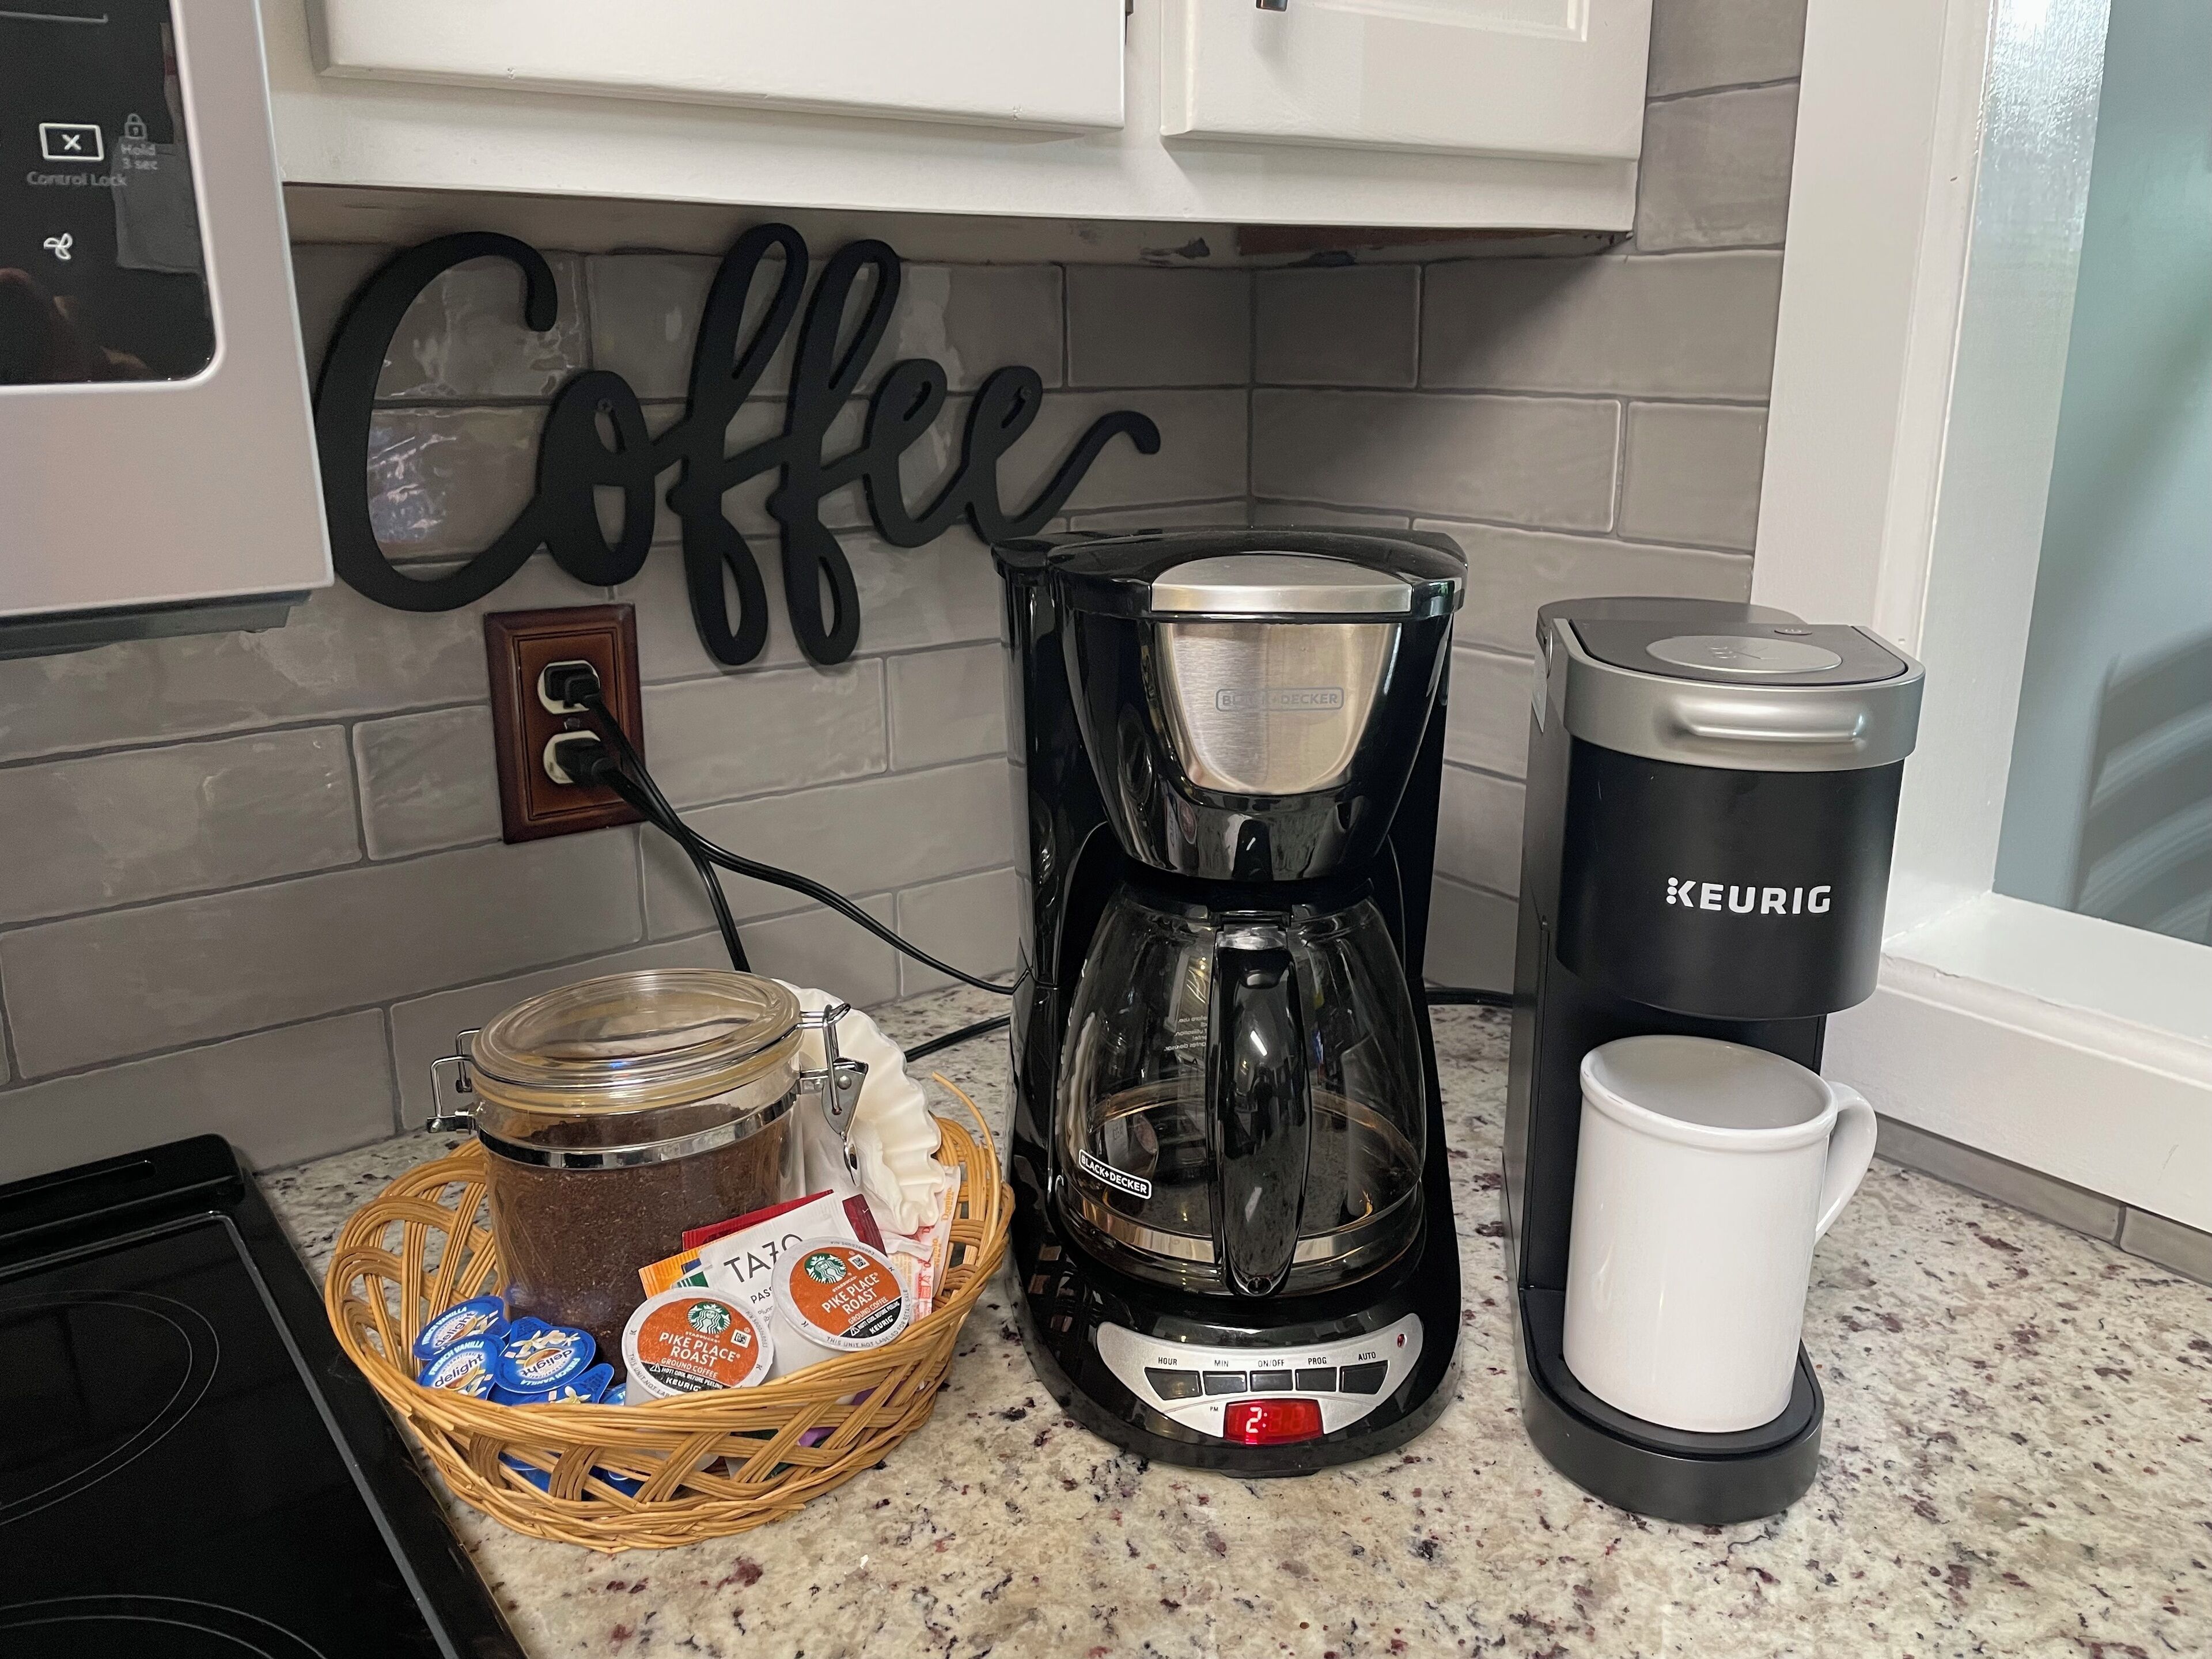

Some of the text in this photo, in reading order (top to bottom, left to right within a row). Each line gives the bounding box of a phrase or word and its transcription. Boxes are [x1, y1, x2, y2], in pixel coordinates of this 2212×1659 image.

[121, 143, 156, 156] Hold
[122, 157, 158, 170] 3 sec
[26, 171, 128, 187] Control Lock
[313, 223, 1161, 665] Coffee
[1666, 877, 1831, 915] KEURIG
[1081, 1154, 1148, 1194] BLACK+DECKER
[821, 1290, 849, 1313] PIKE
[842, 1287, 878, 1315] ROAST
[847, 1296, 889, 1325] GROUND COFFEE
[435, 1312, 476, 1347] delight
[826, 1336, 841, 1346] THIS
[875, 1331, 899, 1345] LABELED
[897, 1322, 907, 1331] FOR
[869, 1315, 893, 1334] KEURIG
[659, 1332, 690, 1348] PIKE
[428, 1340, 484, 1376] FRENCH VANILLA
[521, 1349, 572, 1376] delight
[661, 1358, 719, 1378] GROUND COFFEE
[671, 1346, 717, 1367] ROAST
[1158, 1351, 1376, 1368] HOUR MIN ON/OFF PROG AUTO
[434, 1353, 484, 1388] delight
[520, 1377, 555, 1386] VANILLA
[628, 1354, 637, 1369] THIS
[634, 1366, 645, 1382] UNIT
[645, 1380, 656, 1392] NOT
[674, 1370, 686, 1378] COOL
[687, 1373, 704, 1384] BEFORE
[665, 1377, 702, 1391] KEURIG
